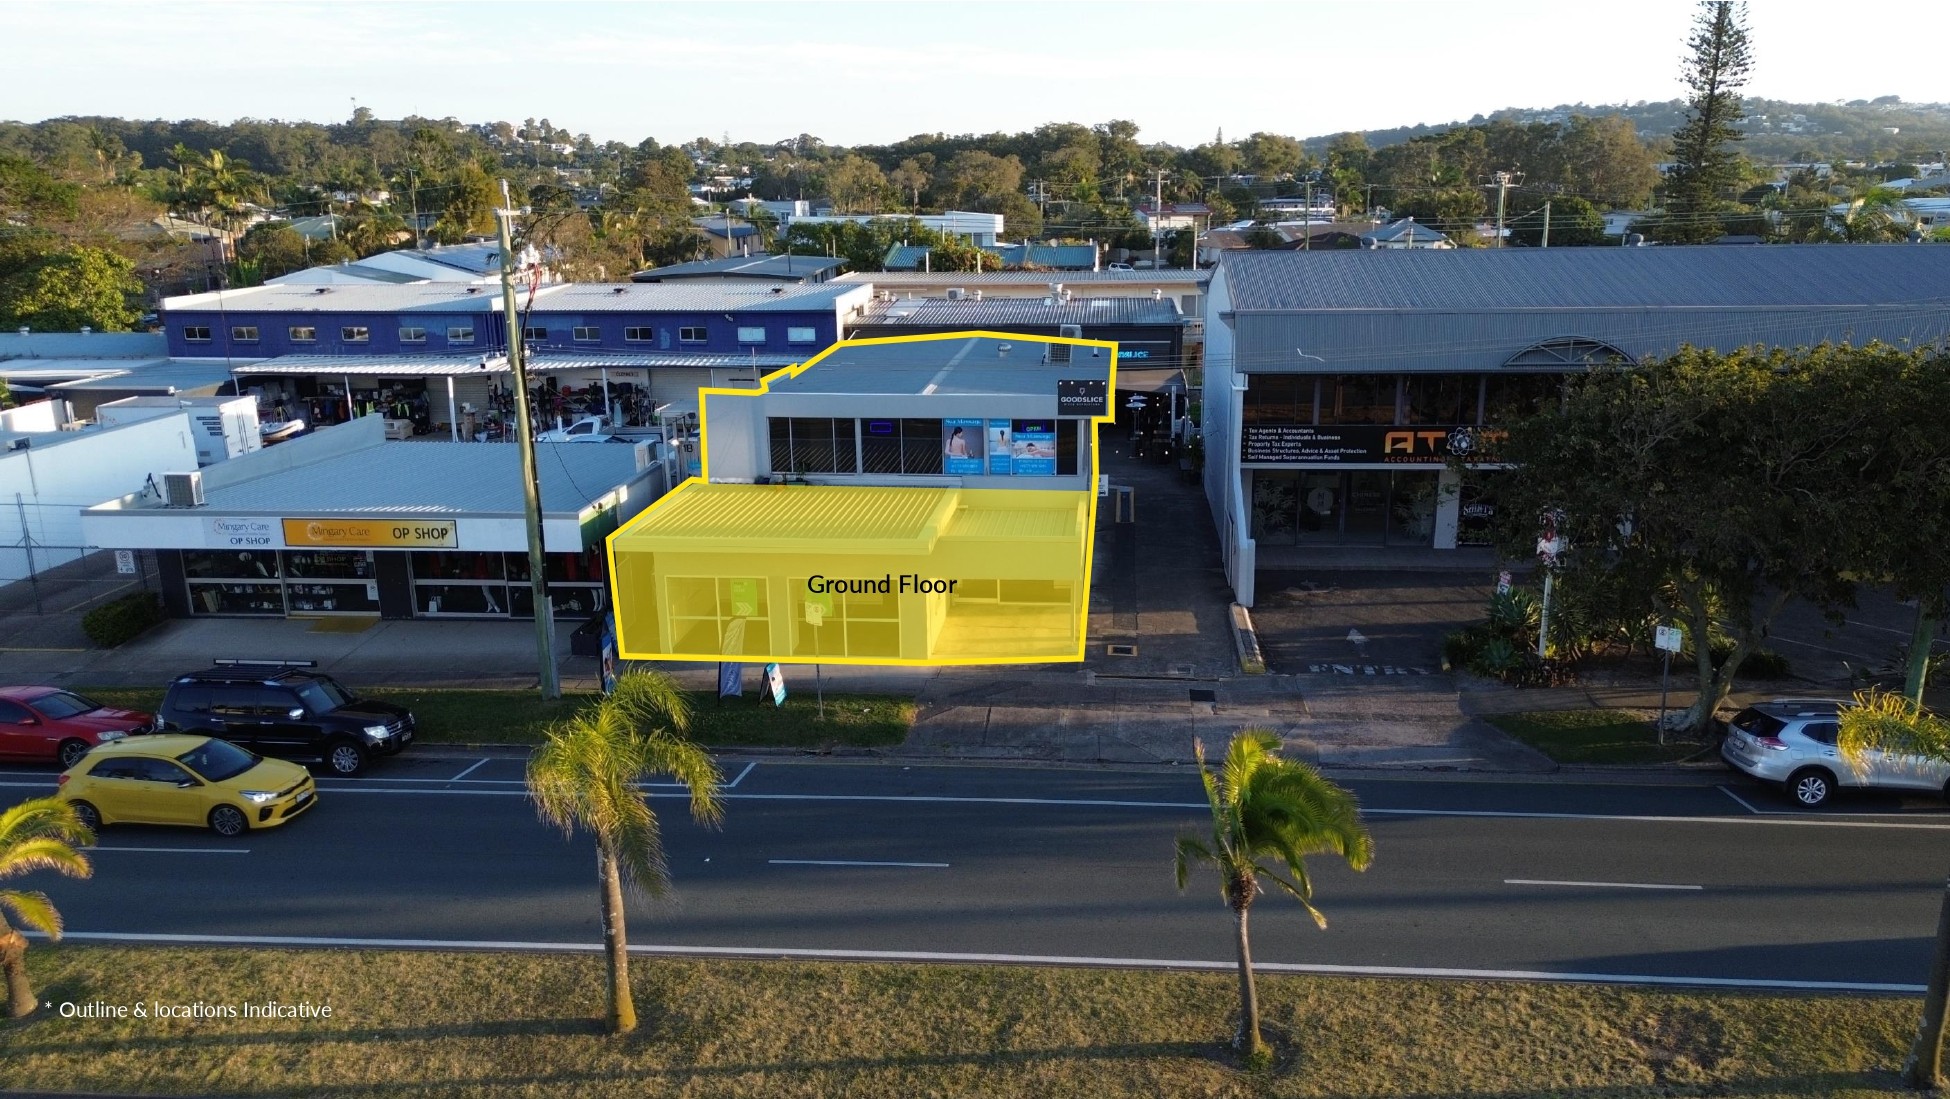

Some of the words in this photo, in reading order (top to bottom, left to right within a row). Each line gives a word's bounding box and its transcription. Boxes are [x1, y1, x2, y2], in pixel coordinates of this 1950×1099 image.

[217, 522, 250, 533] Mingary
[250, 522, 270, 531] Care
[311, 525, 347, 537] Mingary
[348, 525, 370, 536] Care
[393, 527, 410, 538] OP
[414, 526, 449, 540] SHOP
[229, 537, 244, 545] OP
[245, 537, 271, 545] SHOP
